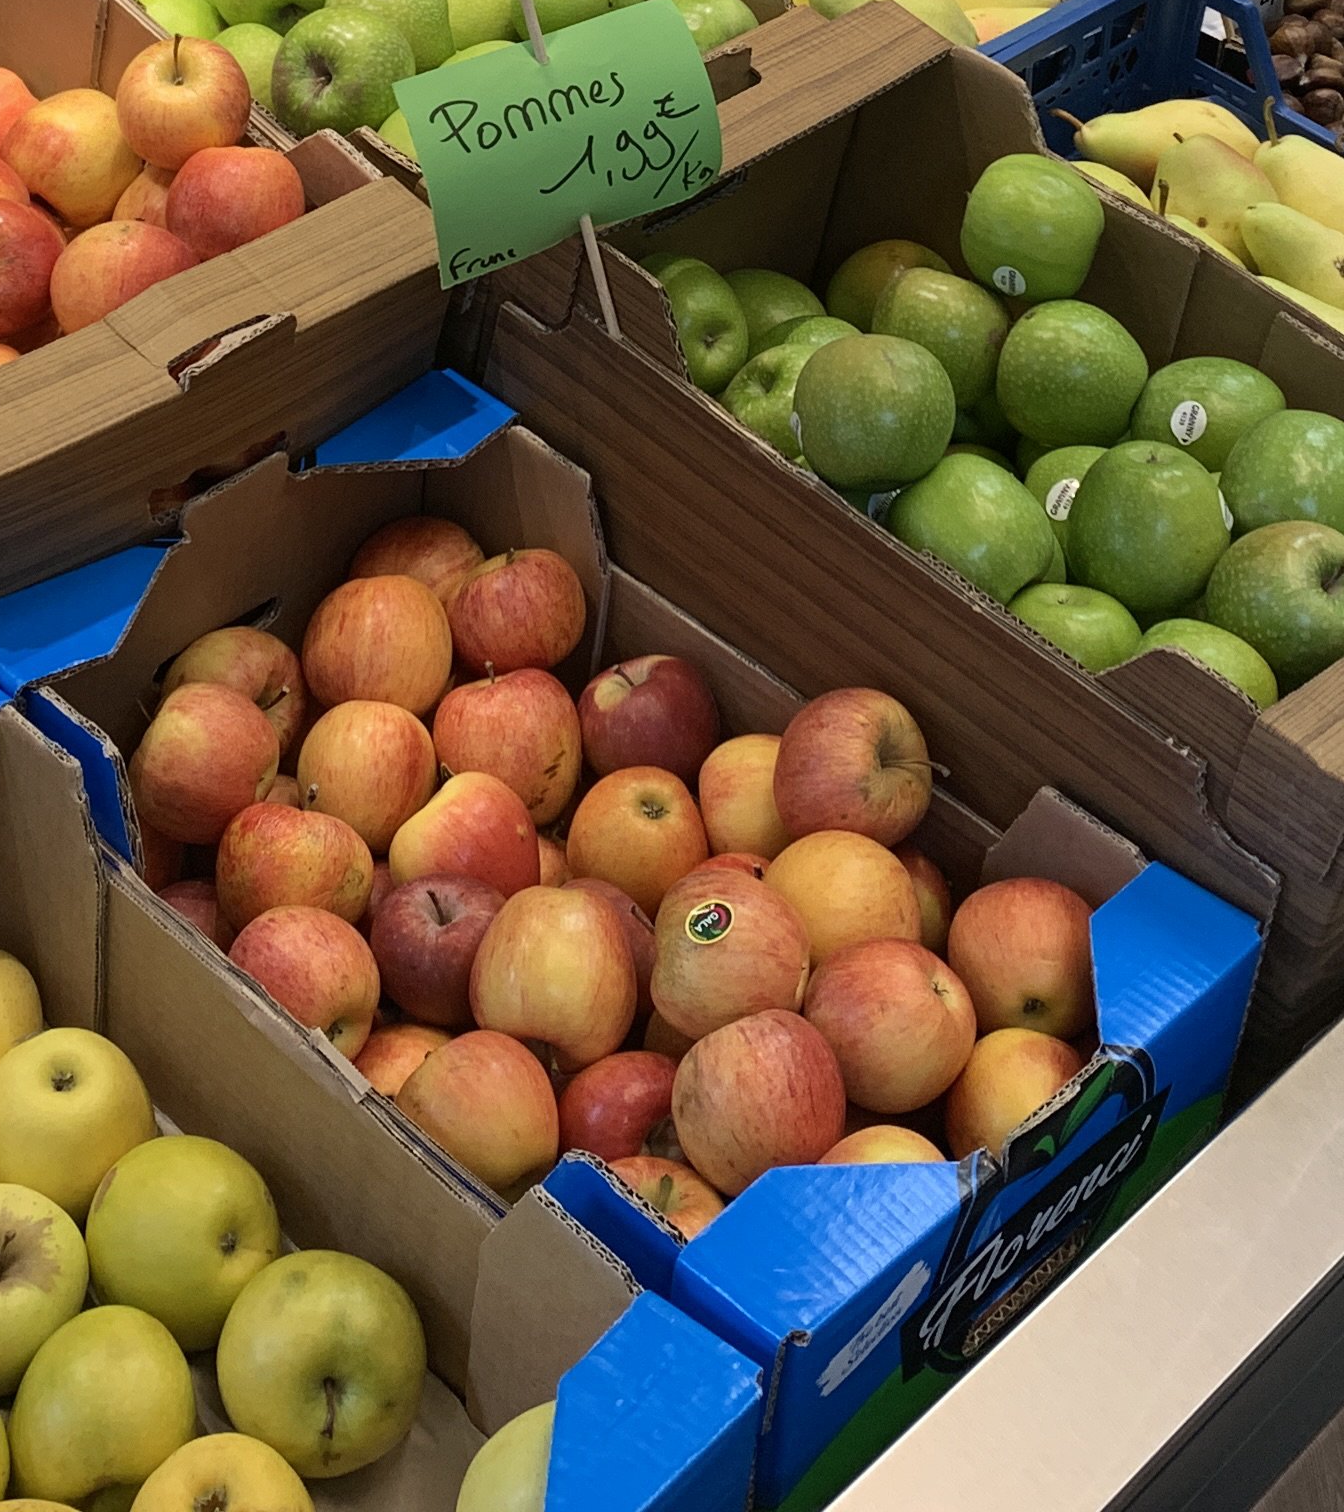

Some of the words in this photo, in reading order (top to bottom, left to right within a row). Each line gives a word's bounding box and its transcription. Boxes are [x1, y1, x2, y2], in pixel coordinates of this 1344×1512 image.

[429, 71, 624, 153] Pommes
[1184, 404, 1200, 439] GRANNY
[919, 1114, 1152, 1351] Florenci
